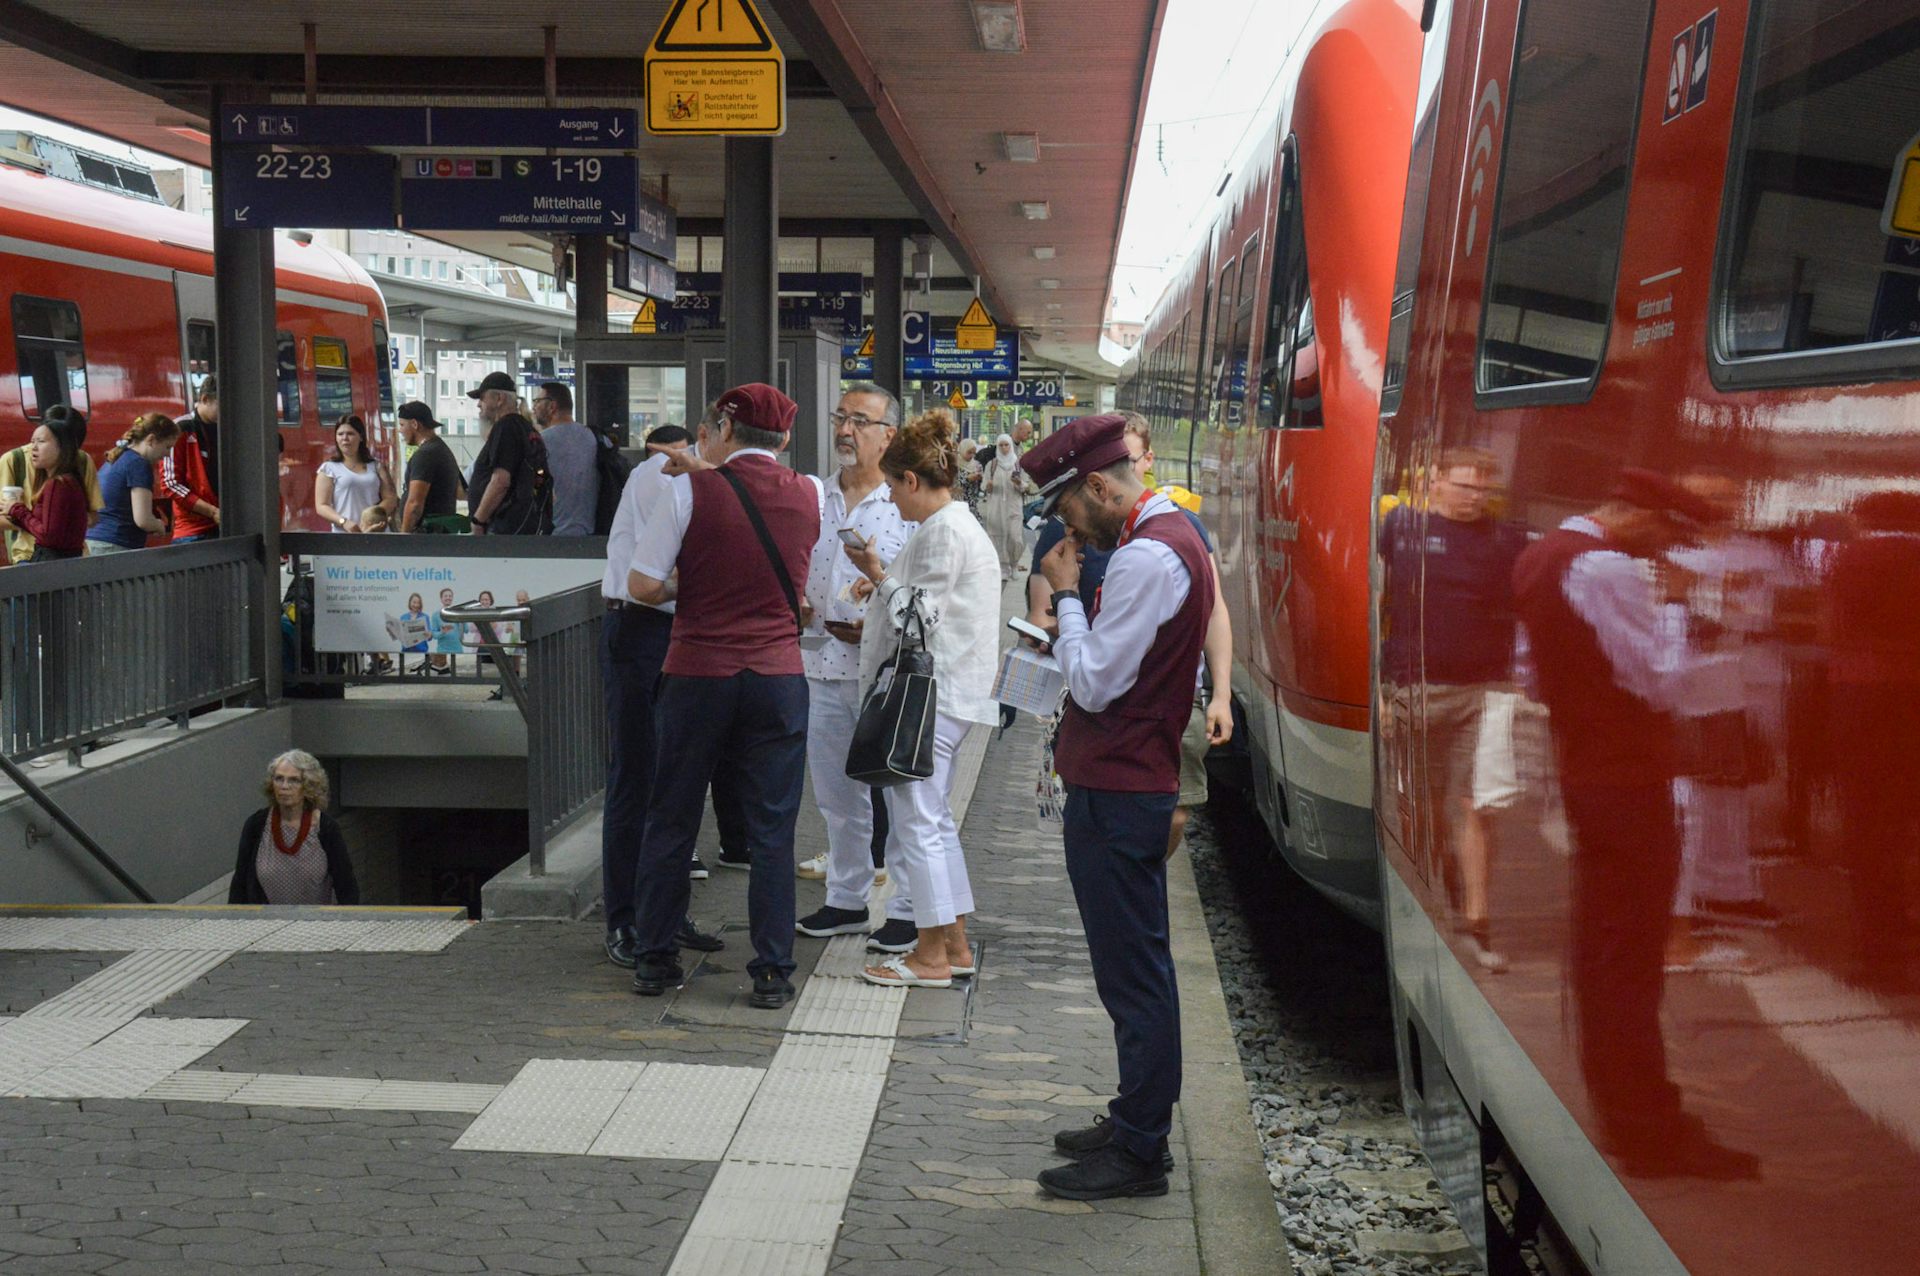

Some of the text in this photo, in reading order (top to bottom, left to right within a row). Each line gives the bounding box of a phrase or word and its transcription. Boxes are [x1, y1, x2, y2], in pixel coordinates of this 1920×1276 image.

[663, 69, 765, 77] Verengter Bahnsteigbereich
[704, 93, 757, 101] Durchfahrt für
[704, 112, 758, 121] nicht geeignet
[559, 119, 599, 131] Ausgang
[256, 154, 332, 180] 22-23
[419, 160, 430, 175] U
[516, 160, 529, 176] S
[551, 157, 602, 183] 1-19
[533, 196, 602, 210] Mittelhalle
[499, 214, 602, 224] middle hall/hall central
[671, 296, 710, 310] 22-23
[820, 296, 845, 310] 1-19
[902, 312, 924, 345] C
[935, 361, 984, 370] Regensburg Hbf
[1035, 380, 1056, 397] 20
[326, 567, 457, 582] Wir bieten Vielfalt.
[326, 584, 400, 594] Immer gut informiert
[326, 593, 337, 602] auf
